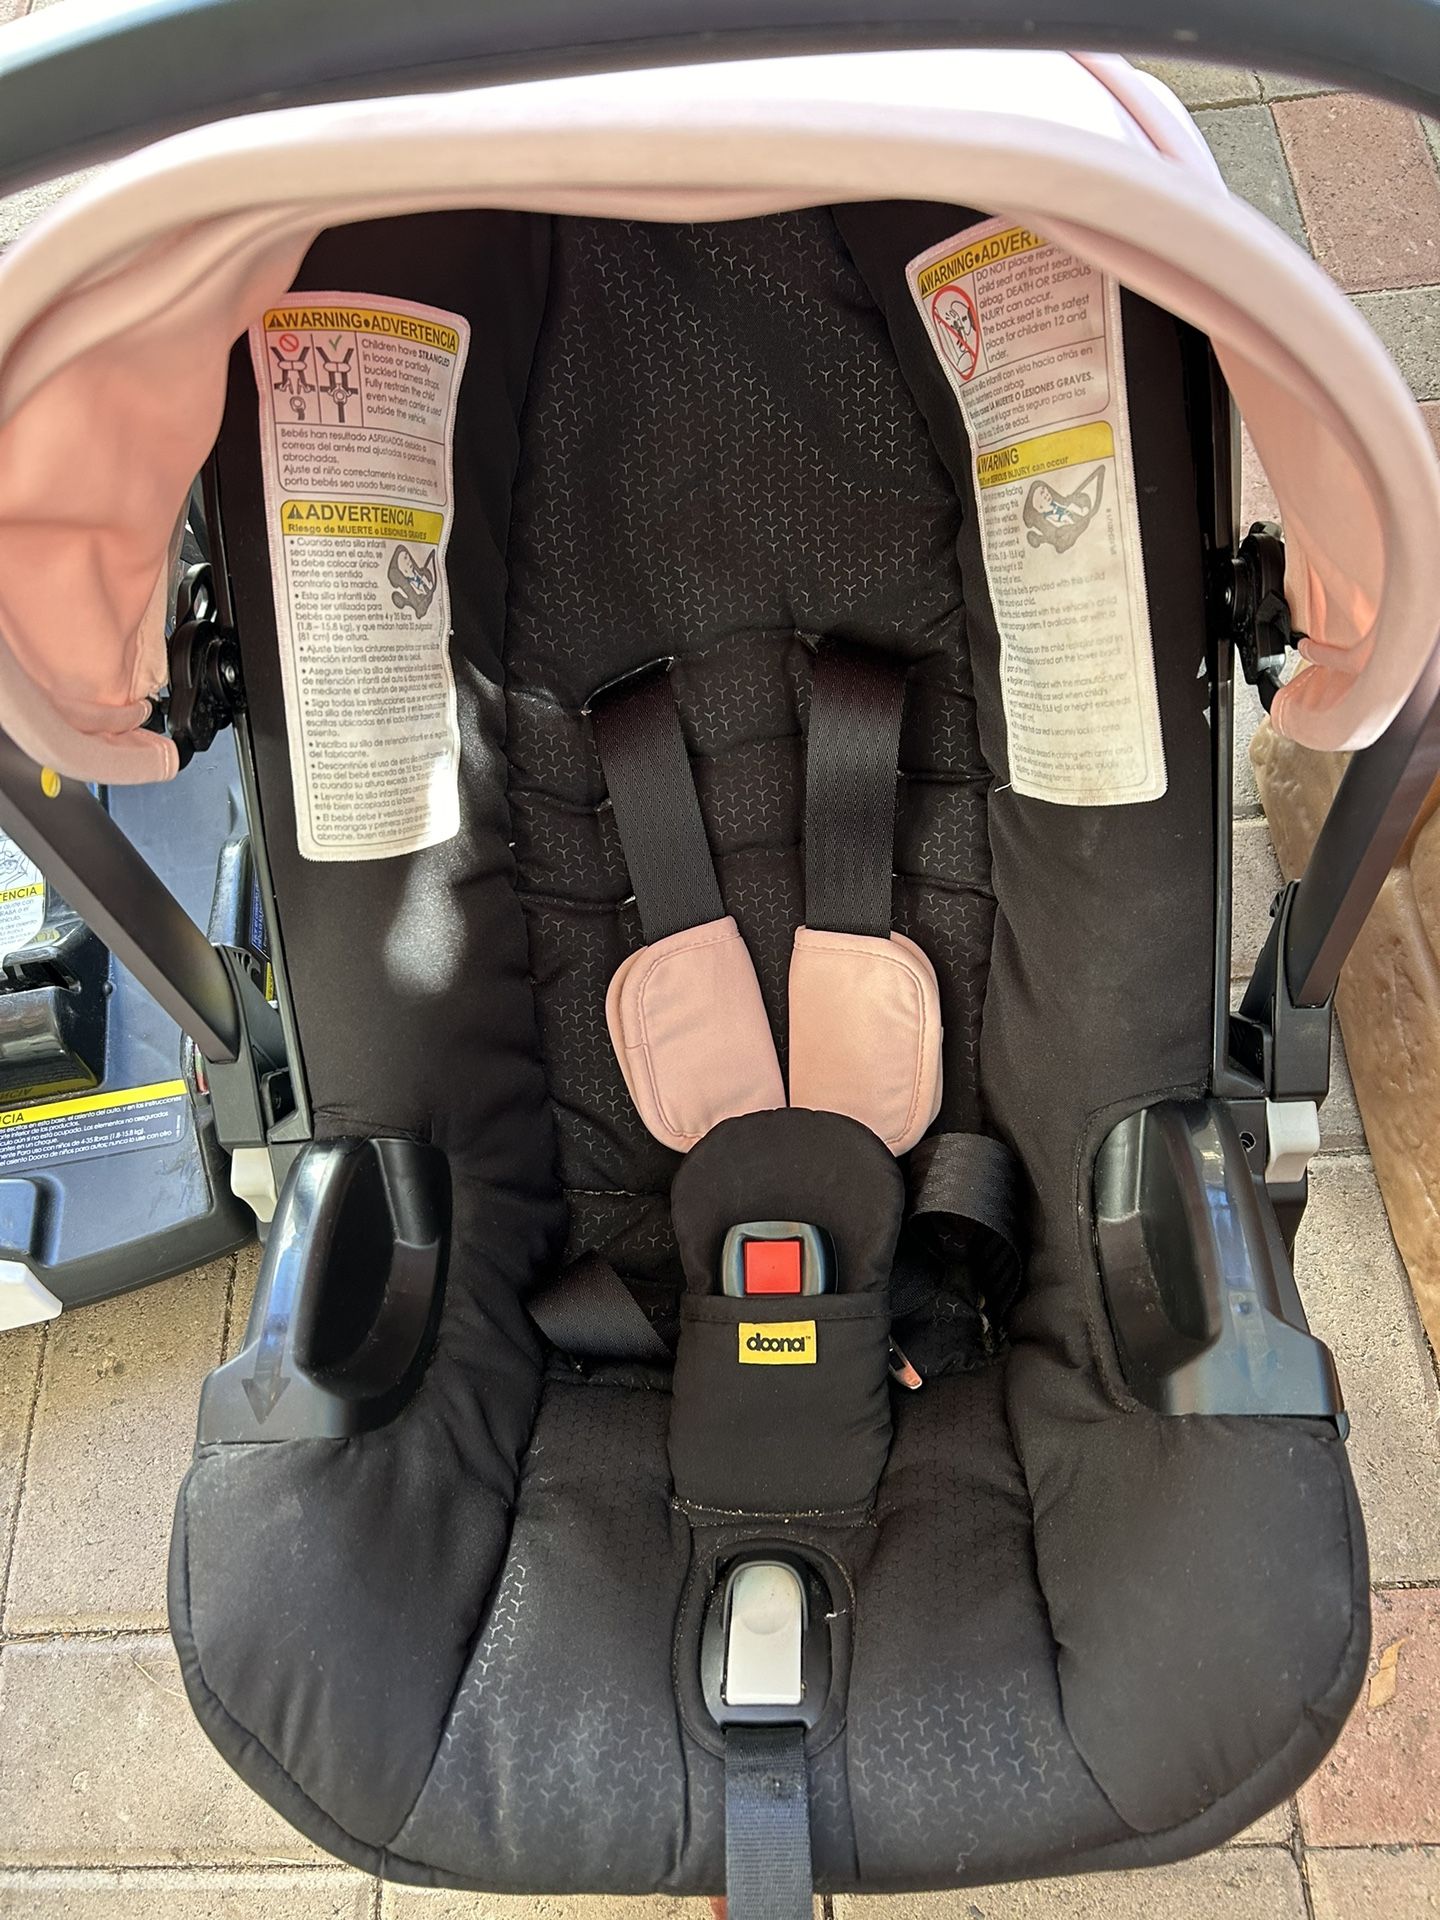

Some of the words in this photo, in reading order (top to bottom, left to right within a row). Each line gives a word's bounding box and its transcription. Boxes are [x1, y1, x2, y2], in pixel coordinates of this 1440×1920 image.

[976, 268, 988, 281] DO
[1008, 255, 1034, 271] place
[978, 280, 995, 295] child
[996, 274, 1013, 288] seat
[1014, 271, 1027, 281] on
[1028, 262, 1049, 275] front
[1052, 257, 1072, 270] seat
[1006, 281, 1034, 298] DEATH
[1036, 276, 1050, 288] OR
[1052, 267, 1091, 284] SERIOUS
[1006, 301, 1022, 312] can
[1024, 292, 1053, 306] occur.
[996, 320, 1016, 330] back
[1017, 313, 1036, 324] seat
[1044, 305, 1059, 315] the
[1061, 294, 1089, 309] safest
[985, 336, 1007, 350] place
[1007, 331, 1017, 341] for
[1018, 321, 1052, 338] children
[1054, 317, 1064, 327] 12
[1066, 311, 1087, 324] and
[361, 339, 397, 352] Children
[398, 344, 417, 357] have
[372, 352, 393, 365] loose
[396, 358, 403, 366] or
[1033, 357, 1055, 368] hacia
[1081, 347, 1092, 355] en
[364, 365, 397, 378] buckled
[365, 378, 383, 391] Fully
[384, 382, 410, 393] restrain
[412, 387, 421, 397] the
[422, 391, 435, 402] child
[1022, 381, 1055, 399] LESIONES
[1057, 372, 1094, 388] GRAVES.
[366, 393, 387, 402] even
[389, 396, 408, 407] when
[1052, 391, 1072, 404] para
[1074, 387, 1086, 397] los
[367, 405, 395, 416] outside
[396, 409, 407, 419] the
[310, 429, 328, 439] han
[330, 432, 367, 441] resultado
[282, 442, 315, 450] correas
[318, 442, 331, 451] del
[357, 445, 372, 454] mal
[284, 464, 311, 475] Ajuste
[313, 465, 321, 474] al
[323, 466, 341, 475] niño
[1008, 465, 1031, 480] INJURY
[1033, 464, 1046, 472] can
[1047, 456, 1069, 469] occur
[284, 477, 309, 487] porta
[340, 480, 354, 488] sea
[356, 481, 378, 489] usado
[306, 504, 414, 527] ADVERTENCIA
[288, 524, 321, 535] Riesgo
[324, 525, 335, 534] de
[337, 526, 373, 535] MUERTE
[297, 538, 333, 548] Cuando
[335, 539, 351, 548] esta
[309, 549, 335, 558] usada
[349, 550, 356, 558] el
[301, 559, 325, 567] debe
[327, 560, 357, 568] colocar
[292, 569, 321, 578] mente
[336, 570, 364, 578] sentido
[301, 592, 319, 600] Esta
[334, 602, 366, 611] utilizada
[333, 771, 348, 779] del
[320, 782, 353, 790] cuando
[320, 792, 354, 801] Levante
[0, 1113, 24, 1125] CIA
[74, 1111, 95, 1120] asiento
[134, 1111, 169, 1122] asegurados
[6, 1157, 28, 1166] asiento
[28, 1152, 49, 1162] Doona
[75, 1145, 90, 1154] para
[109, 1138, 128, 1147] nunca
[135, 1134, 146, 1142] use
[160, 1129, 172, 1137] otro
[71, 1139, 80, 1147] de
